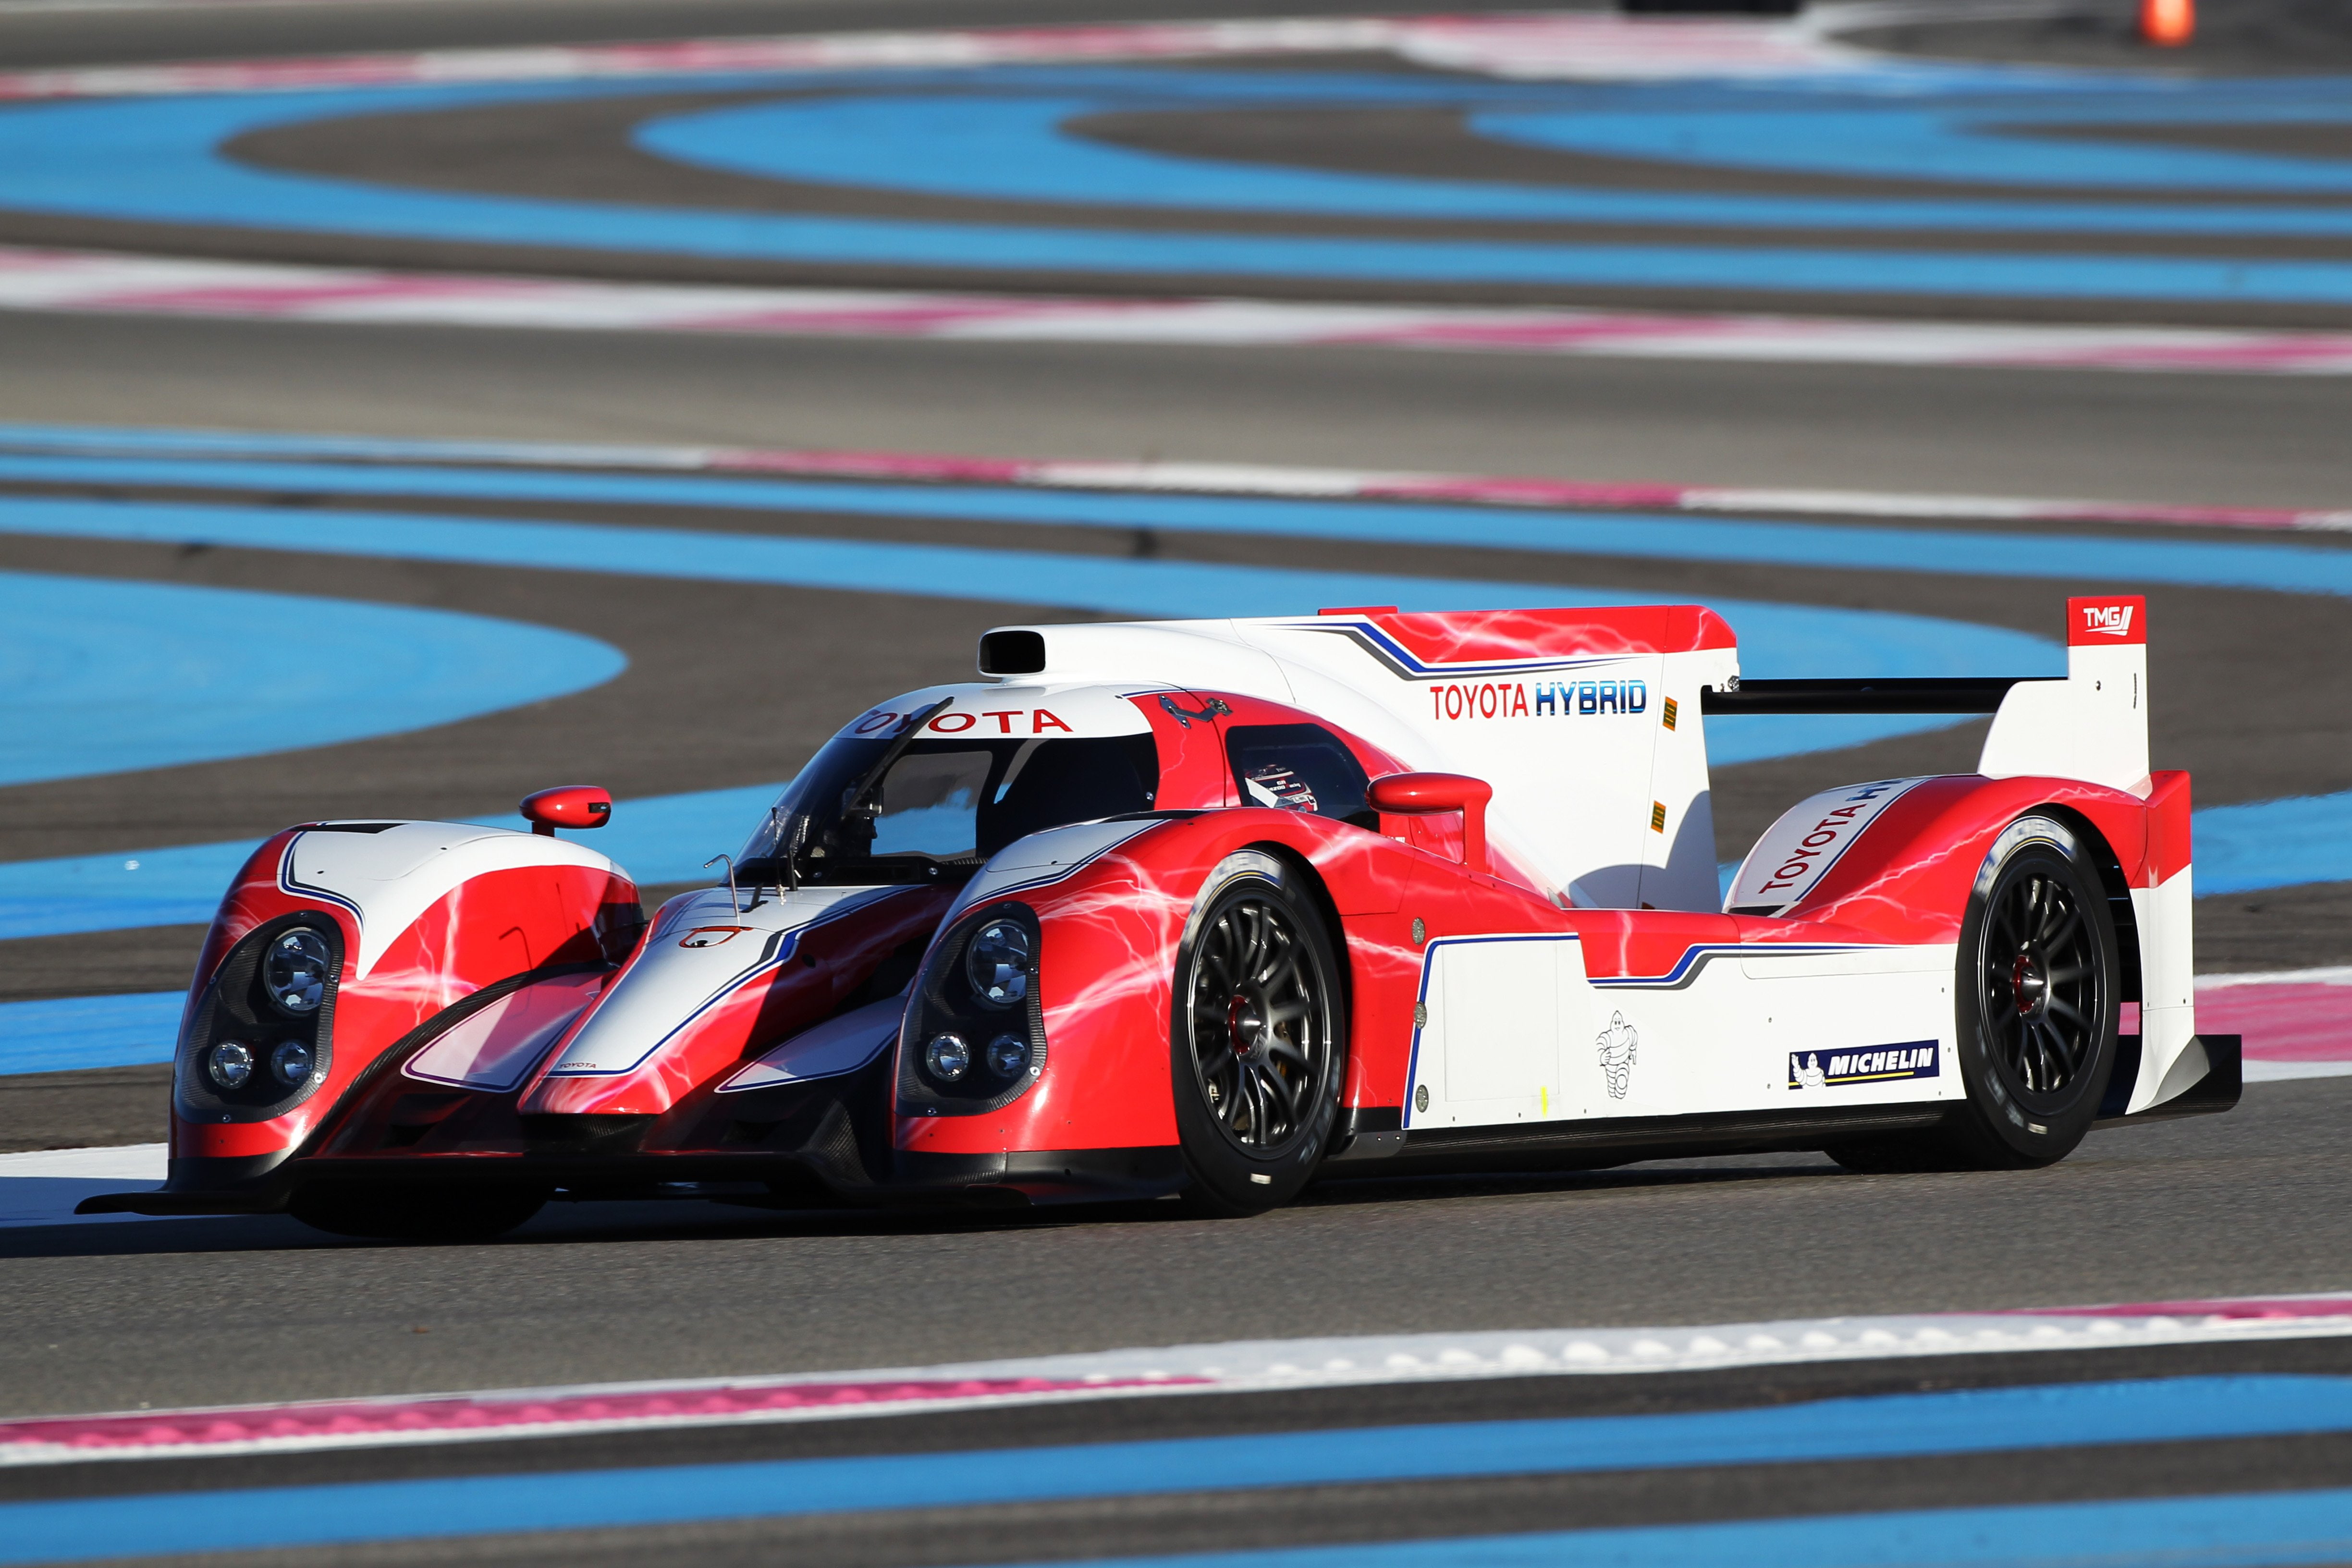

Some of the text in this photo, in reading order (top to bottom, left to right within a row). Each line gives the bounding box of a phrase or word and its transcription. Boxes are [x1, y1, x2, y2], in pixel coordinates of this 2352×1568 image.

[1430, 680, 1647, 720] TOYOTA HYBRID
[1758, 803, 1867, 894] TOYOTA
[1827, 1047, 1934, 1076] MICHELIN
